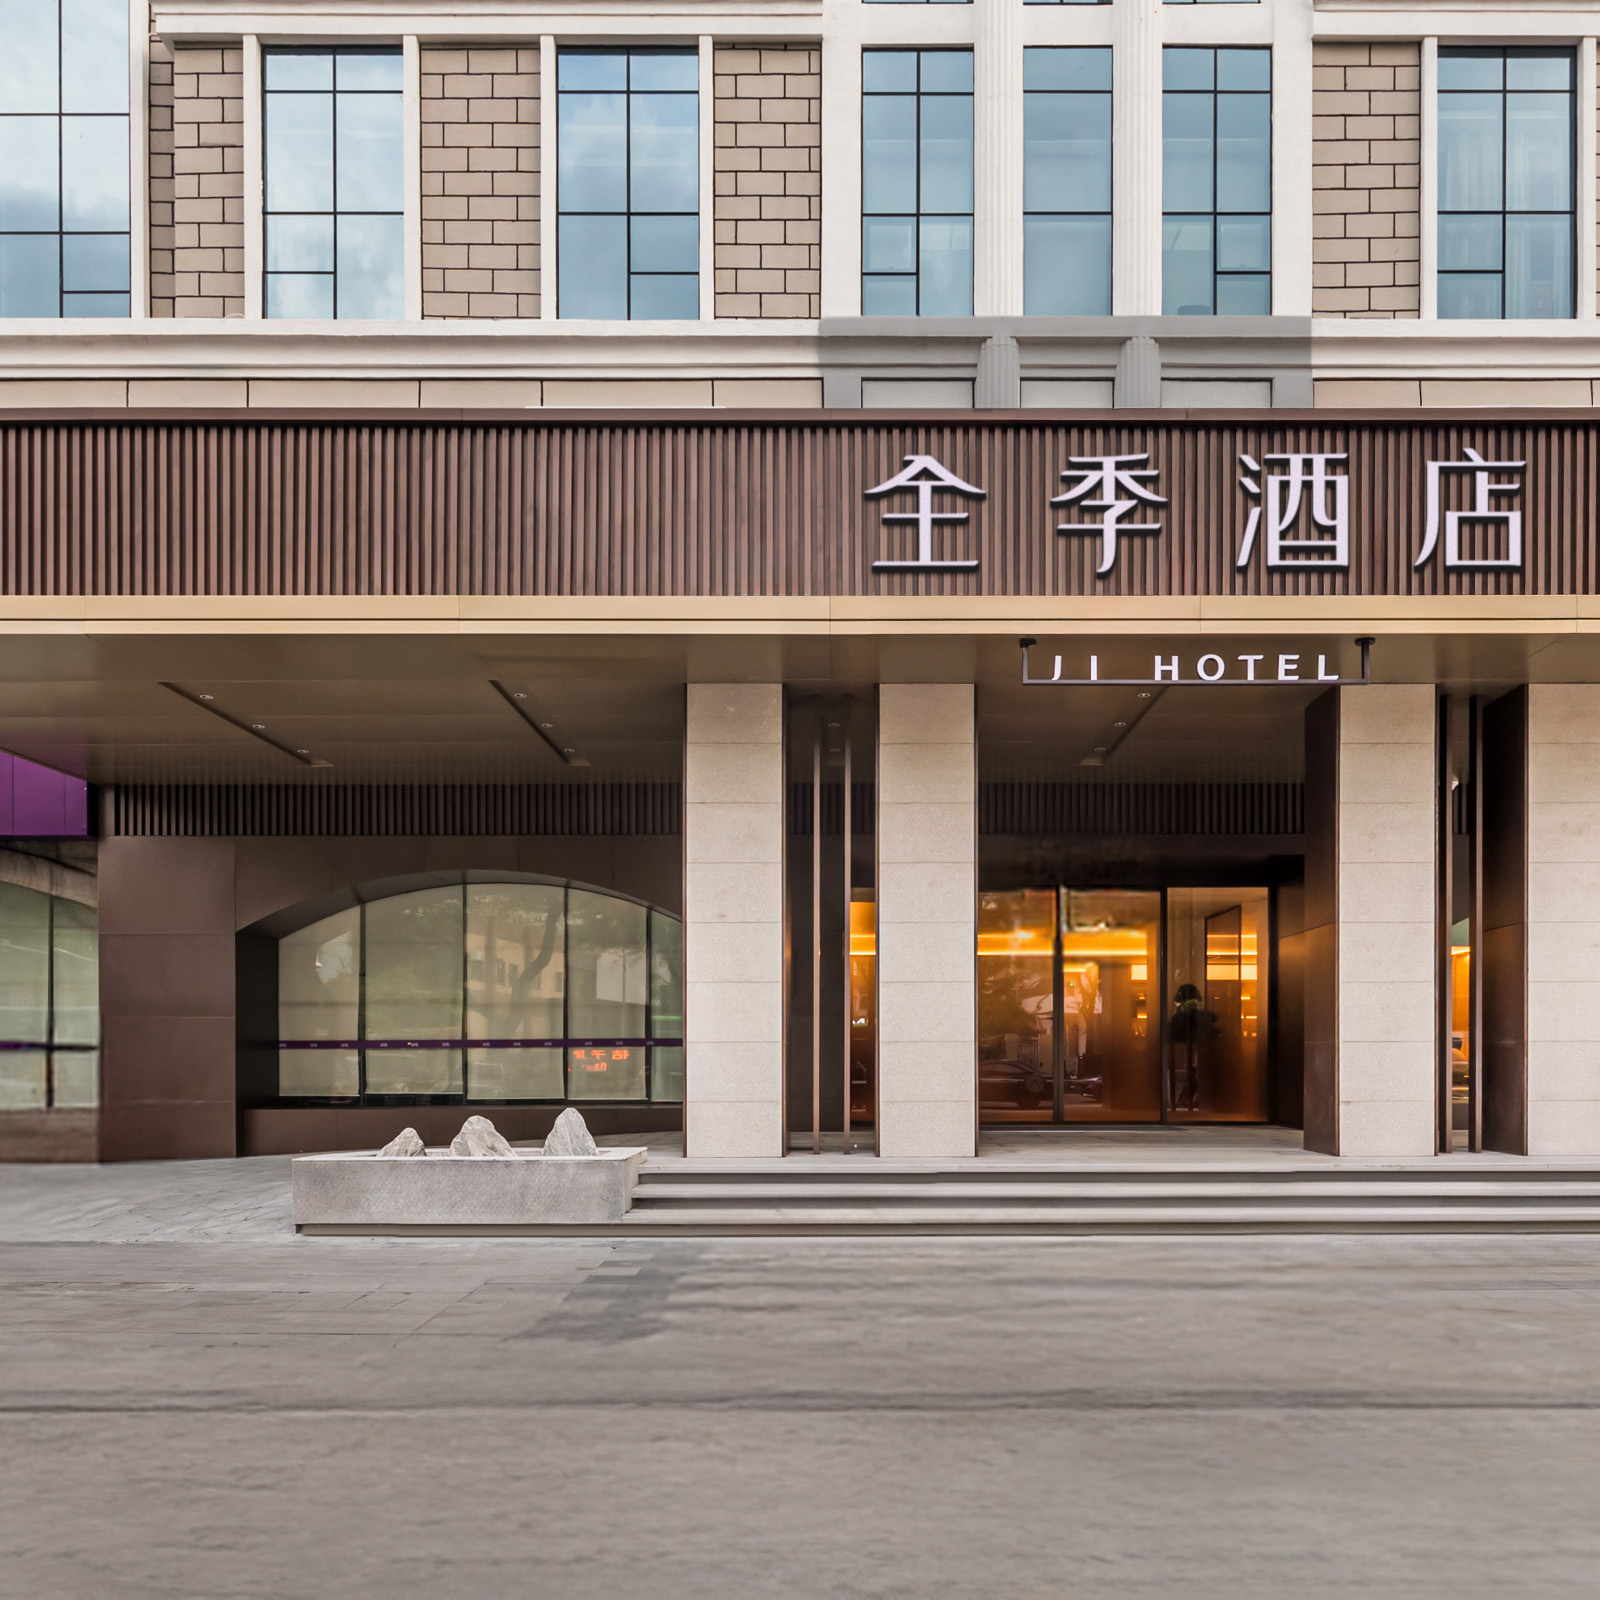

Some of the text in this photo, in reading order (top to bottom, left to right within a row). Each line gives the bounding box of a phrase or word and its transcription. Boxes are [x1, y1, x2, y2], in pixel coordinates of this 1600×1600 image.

[863, 447, 1527, 575] 全季酒店
[1051, 653, 1340, 682] JI HOTEL
